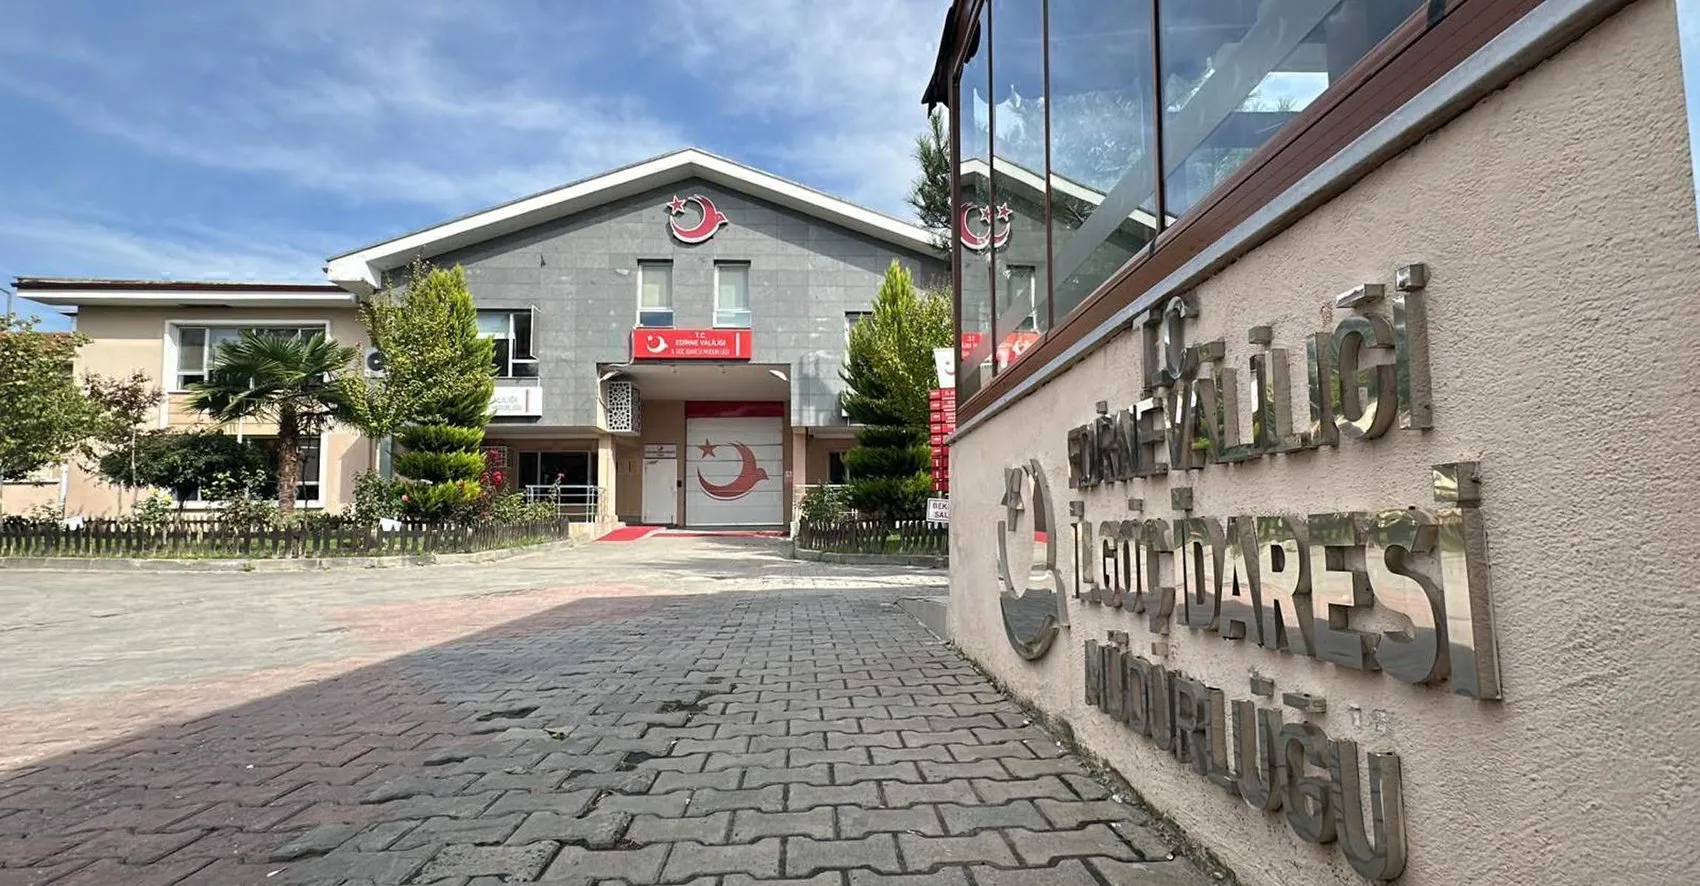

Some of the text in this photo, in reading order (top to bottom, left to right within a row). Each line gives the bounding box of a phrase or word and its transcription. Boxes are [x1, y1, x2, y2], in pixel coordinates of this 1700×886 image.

[1067, 397, 1168, 489] EDİRNE
[933, 502, 949, 510] BEK
[1171, 461, 1503, 700] İDARESİ
